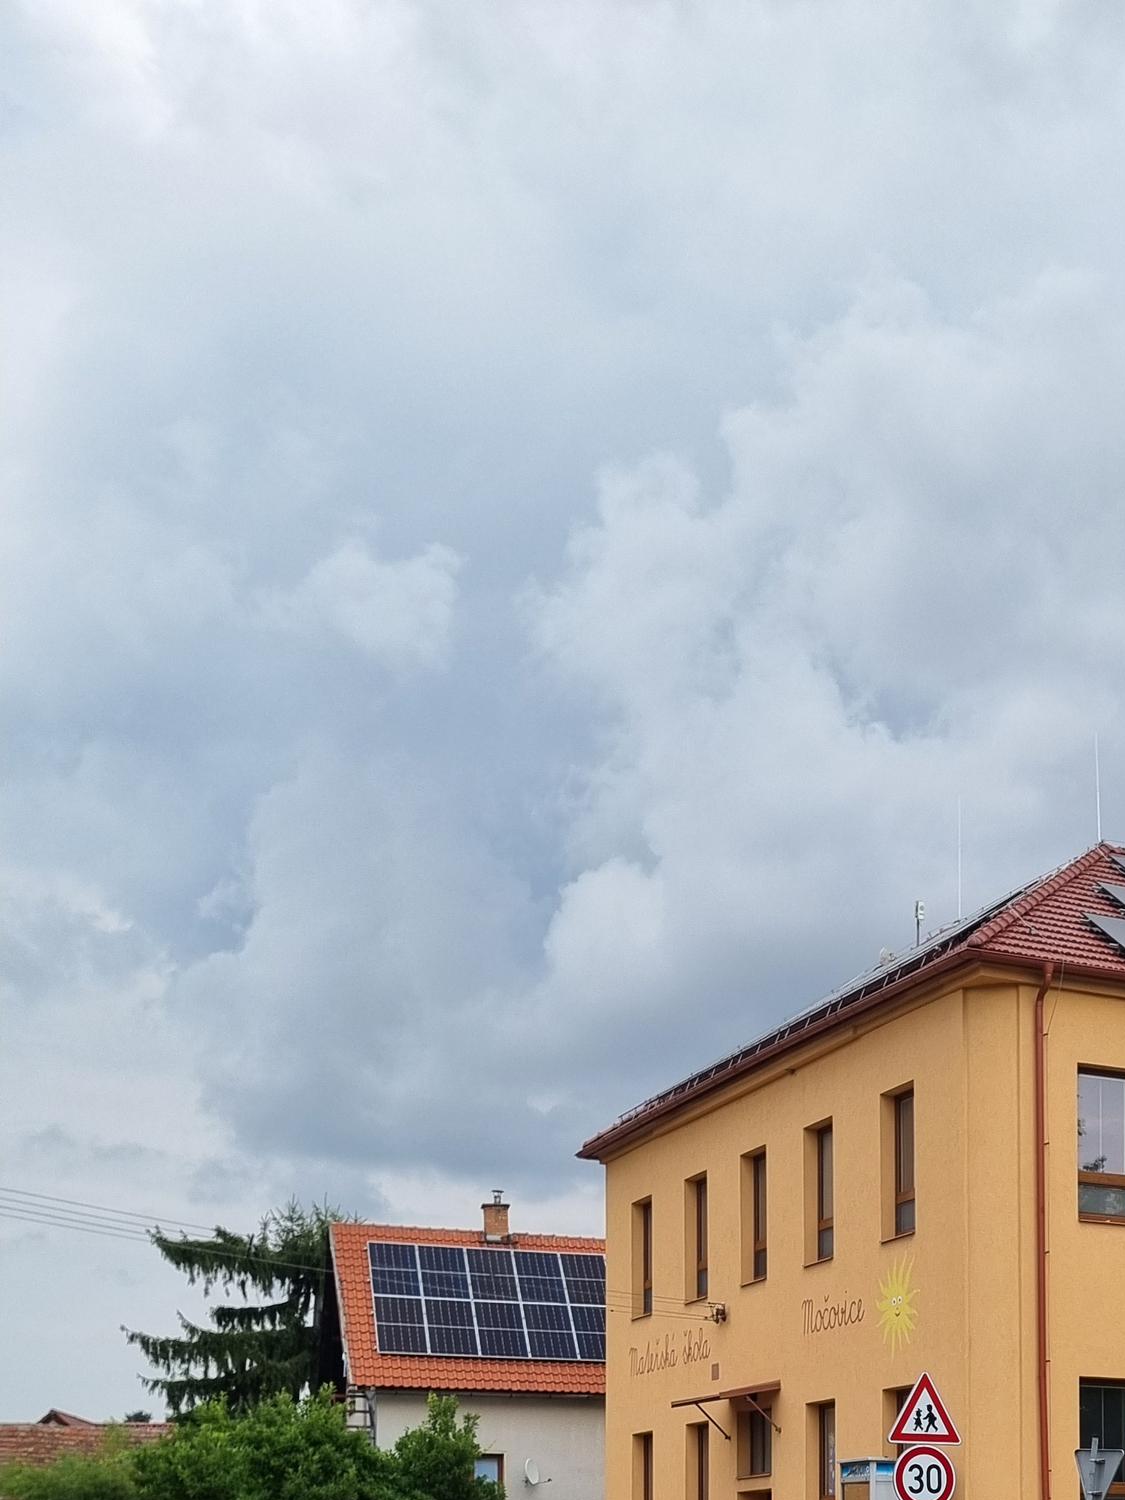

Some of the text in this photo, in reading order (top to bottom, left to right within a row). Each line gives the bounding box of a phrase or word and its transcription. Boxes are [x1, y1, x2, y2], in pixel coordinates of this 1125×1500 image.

[682, 1327, 711, 1365] škola
[801, 1290, 865, 1336] Močovice
[907, 1463, 943, 1494] 30
